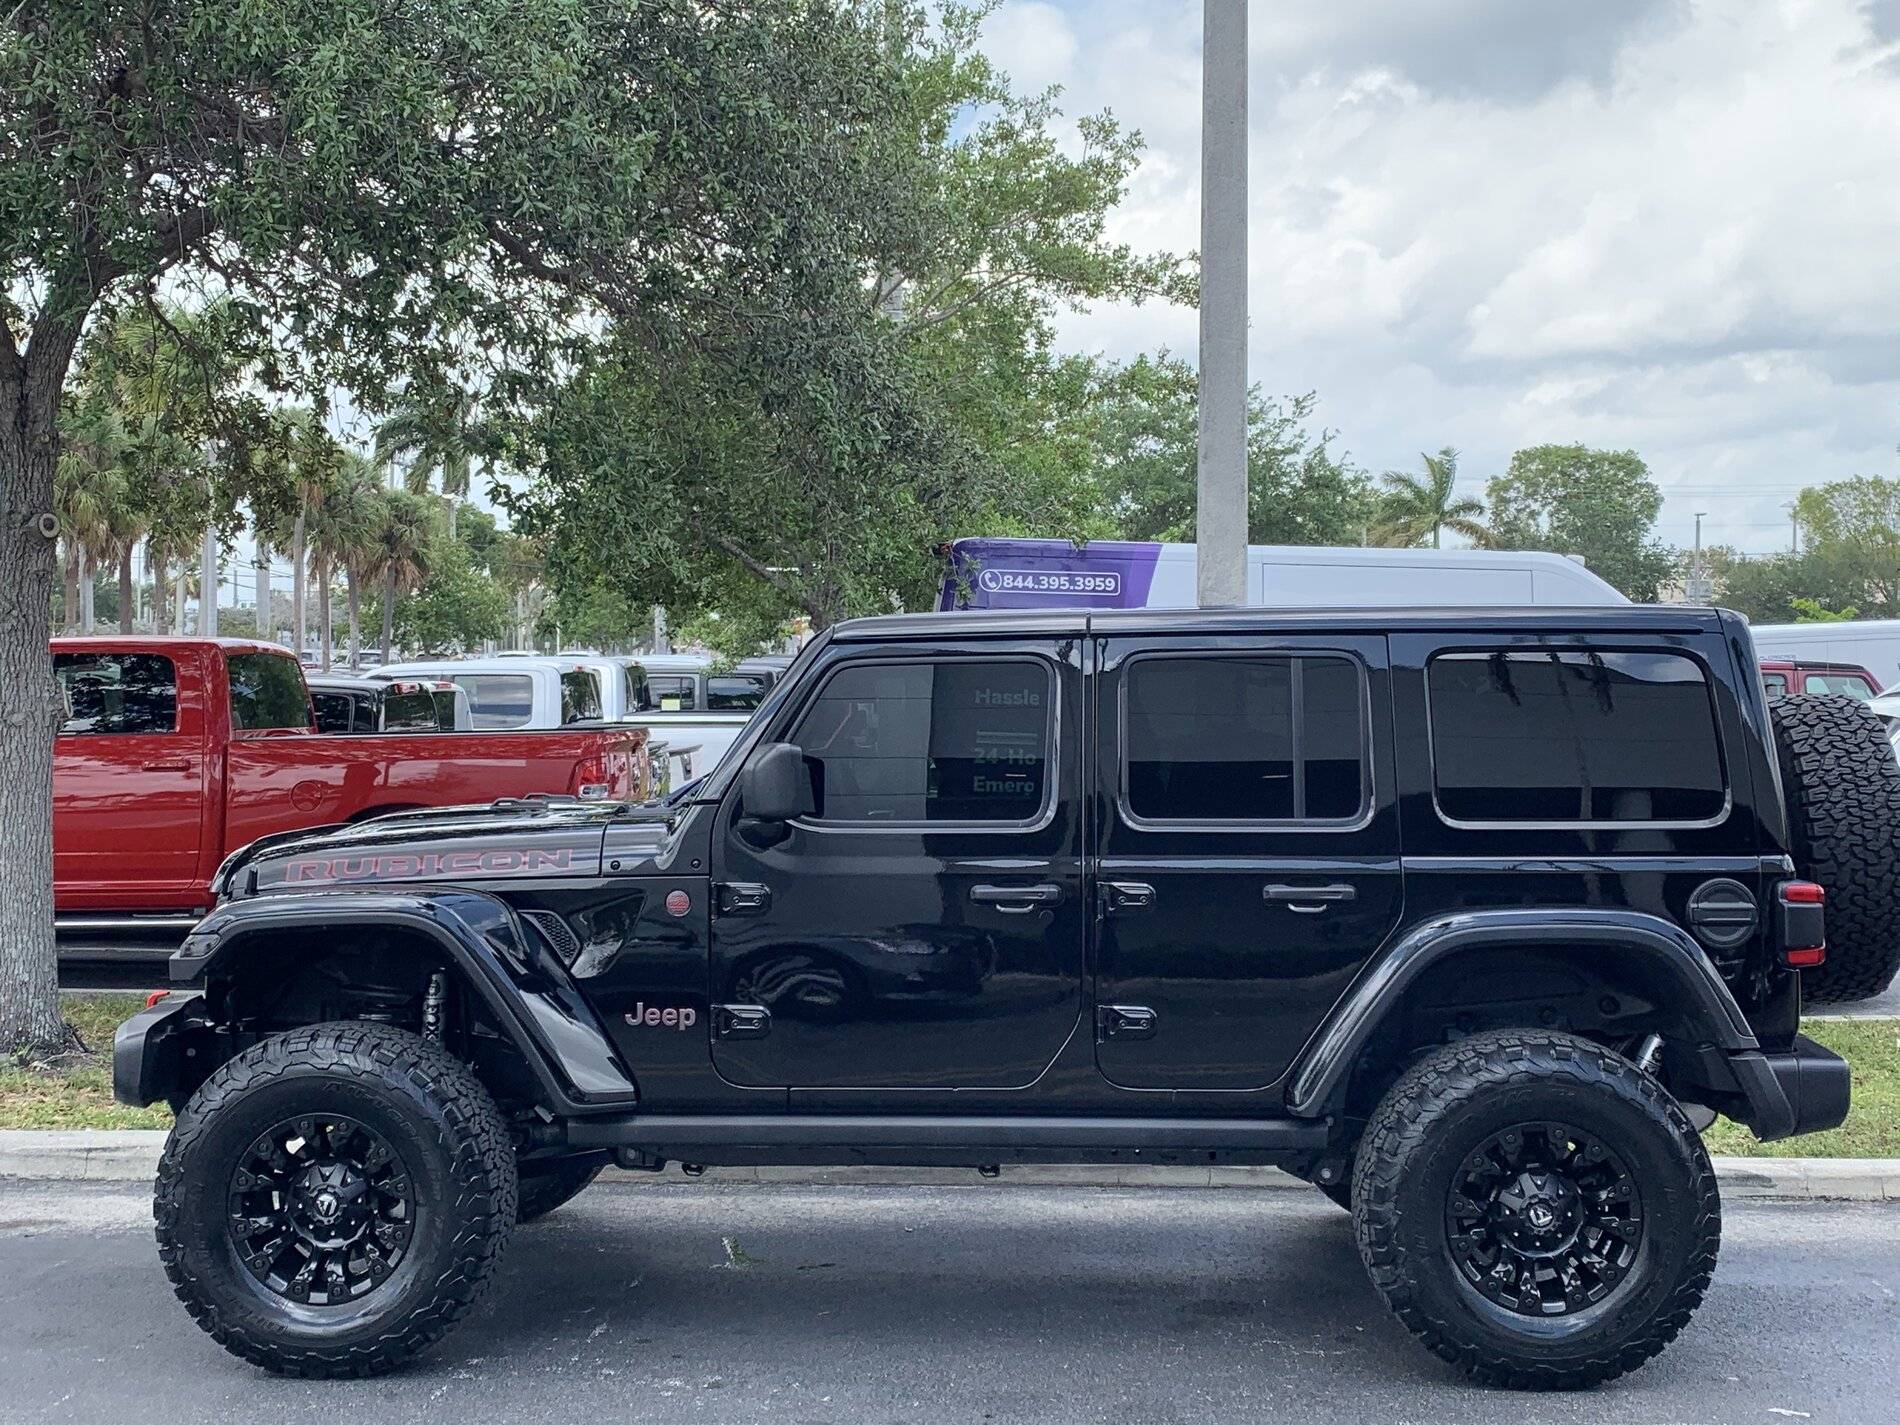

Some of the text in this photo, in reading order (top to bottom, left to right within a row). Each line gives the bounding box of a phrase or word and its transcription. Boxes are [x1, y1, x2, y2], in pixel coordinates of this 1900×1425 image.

[1003, 574, 1115, 591] 844.395.3959
[975, 689, 1040, 706] Hassle
[286, 849, 573, 882] RUBICON
[624, 1001, 696, 1031] Jeep
